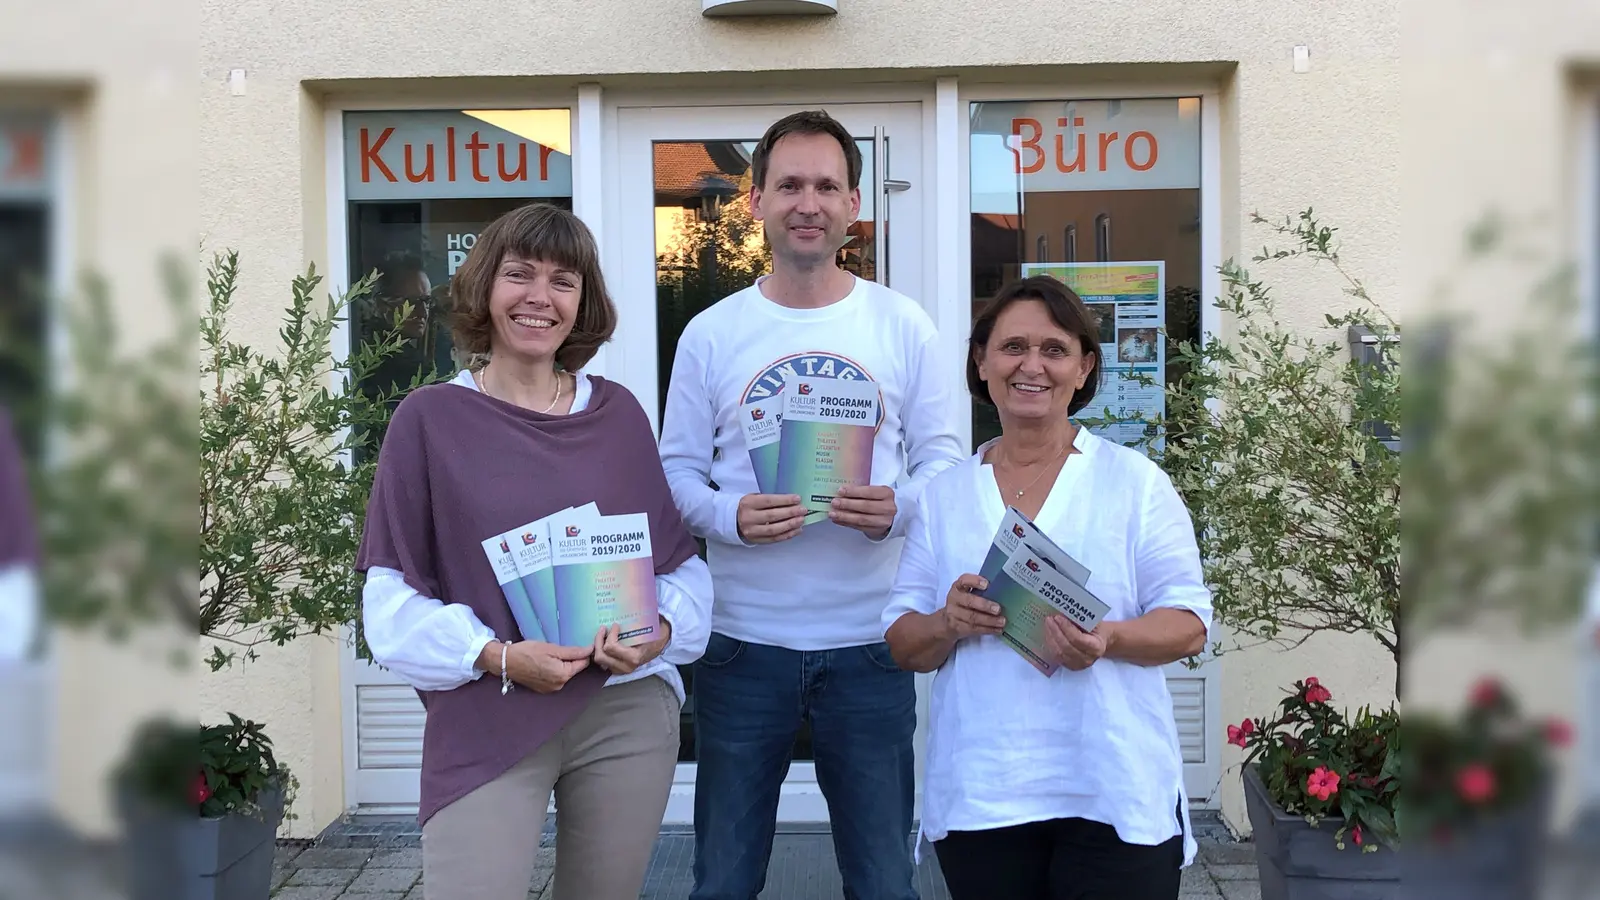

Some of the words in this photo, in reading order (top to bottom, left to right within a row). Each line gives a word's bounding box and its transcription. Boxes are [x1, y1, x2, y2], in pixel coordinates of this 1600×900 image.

[1011, 117, 1158, 174] Büro
[360, 127, 560, 183] Kultur
[447, 233, 482, 250] HO
[448, 250, 467, 276] P
[750, 358, 870, 399] VINTAG
[790, 397, 816, 405] KULTUR
[820, 396, 872, 409] PROGRAMM
[819, 408, 867, 419] 2019/2020
[748, 419, 774, 432] KULTUR
[558, 538, 587, 548] KULTUR
[591, 531, 645, 545] PROGRAMM
[519, 542, 547, 558] KULTUR
[592, 543, 641, 556] 2019/2020
[498, 553, 513, 565] KUL
[1015, 561, 1041, 583] KULTUR
[1038, 587, 1086, 622] 2019/2020
[1043, 581, 1096, 620] PROGRAMM
